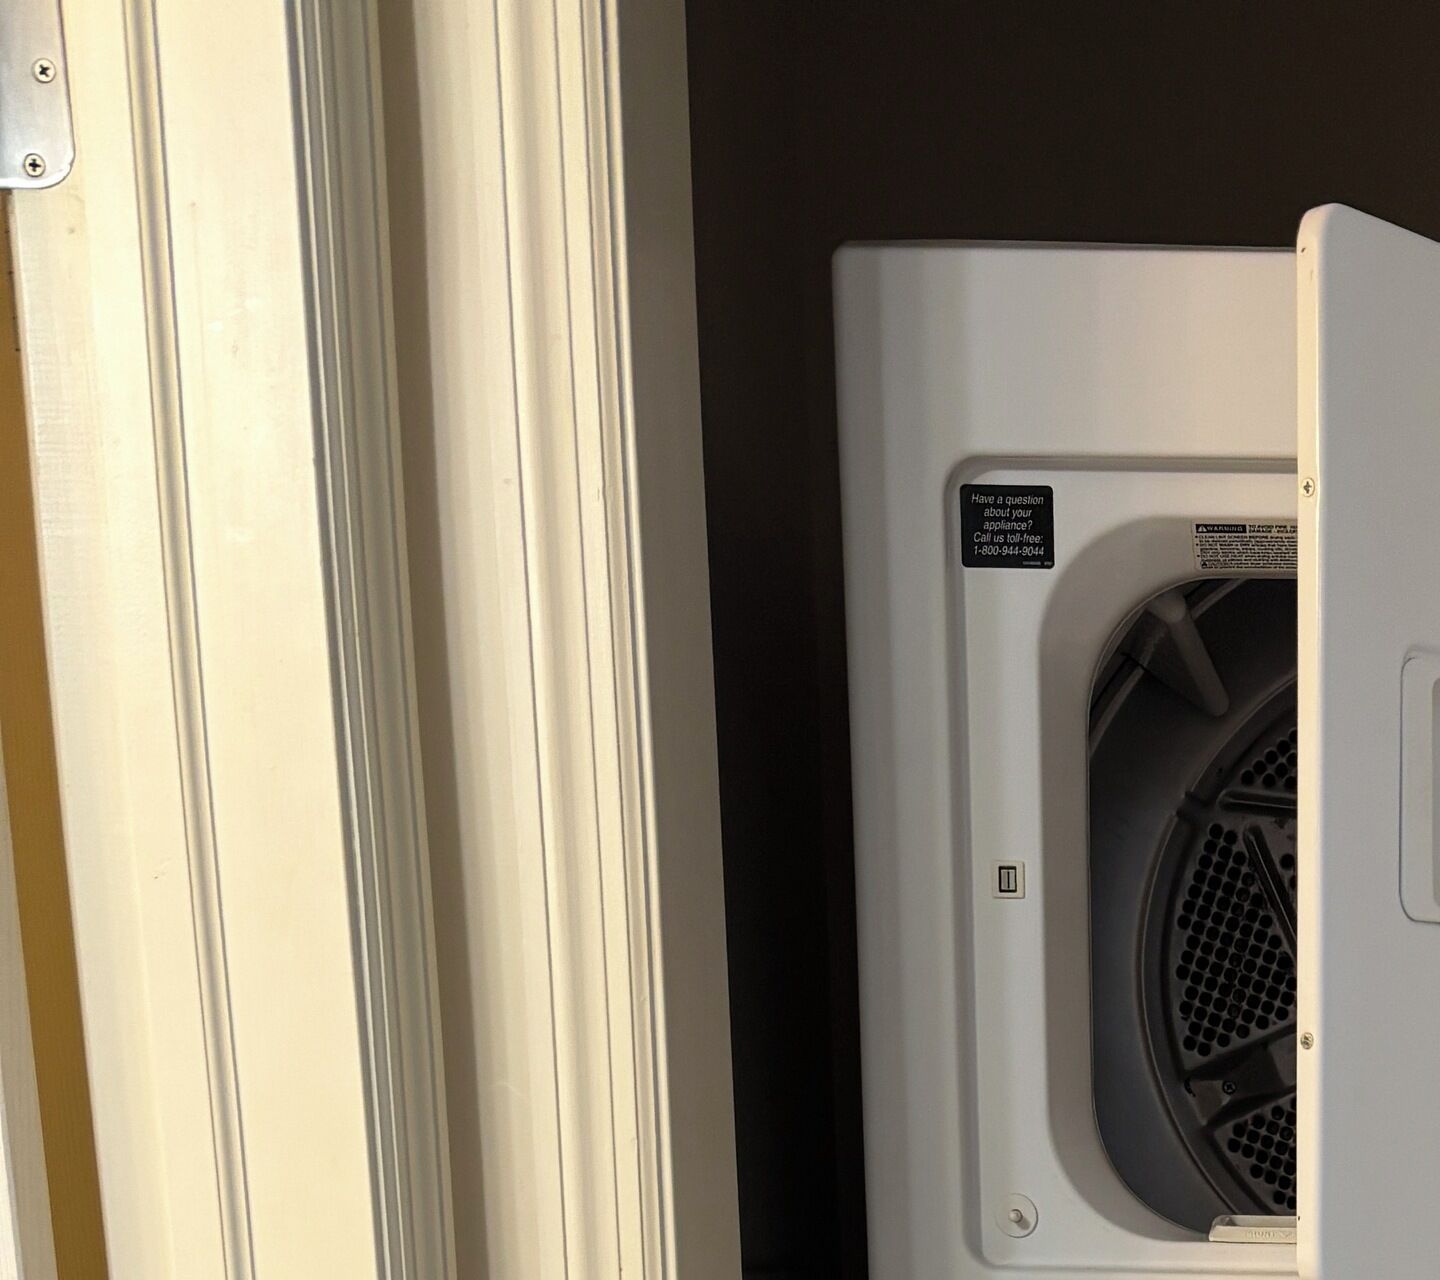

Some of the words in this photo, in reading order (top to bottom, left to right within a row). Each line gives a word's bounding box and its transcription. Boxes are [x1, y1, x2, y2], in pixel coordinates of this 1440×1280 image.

[971, 492, 994, 504] Have
[997, 496, 1003, 504] a
[1006, 495, 1044, 506] question
[984, 507, 1010, 517] about
[1012, 509, 1032, 520] your
[984, 520, 1033, 532] appliance?
[973, 531, 991, 543] Call
[993, 534, 1004, 542] us
[1007, 533, 1043, 543] toll-free:
[974, 545, 1044, 556] 1-800-944-9044
